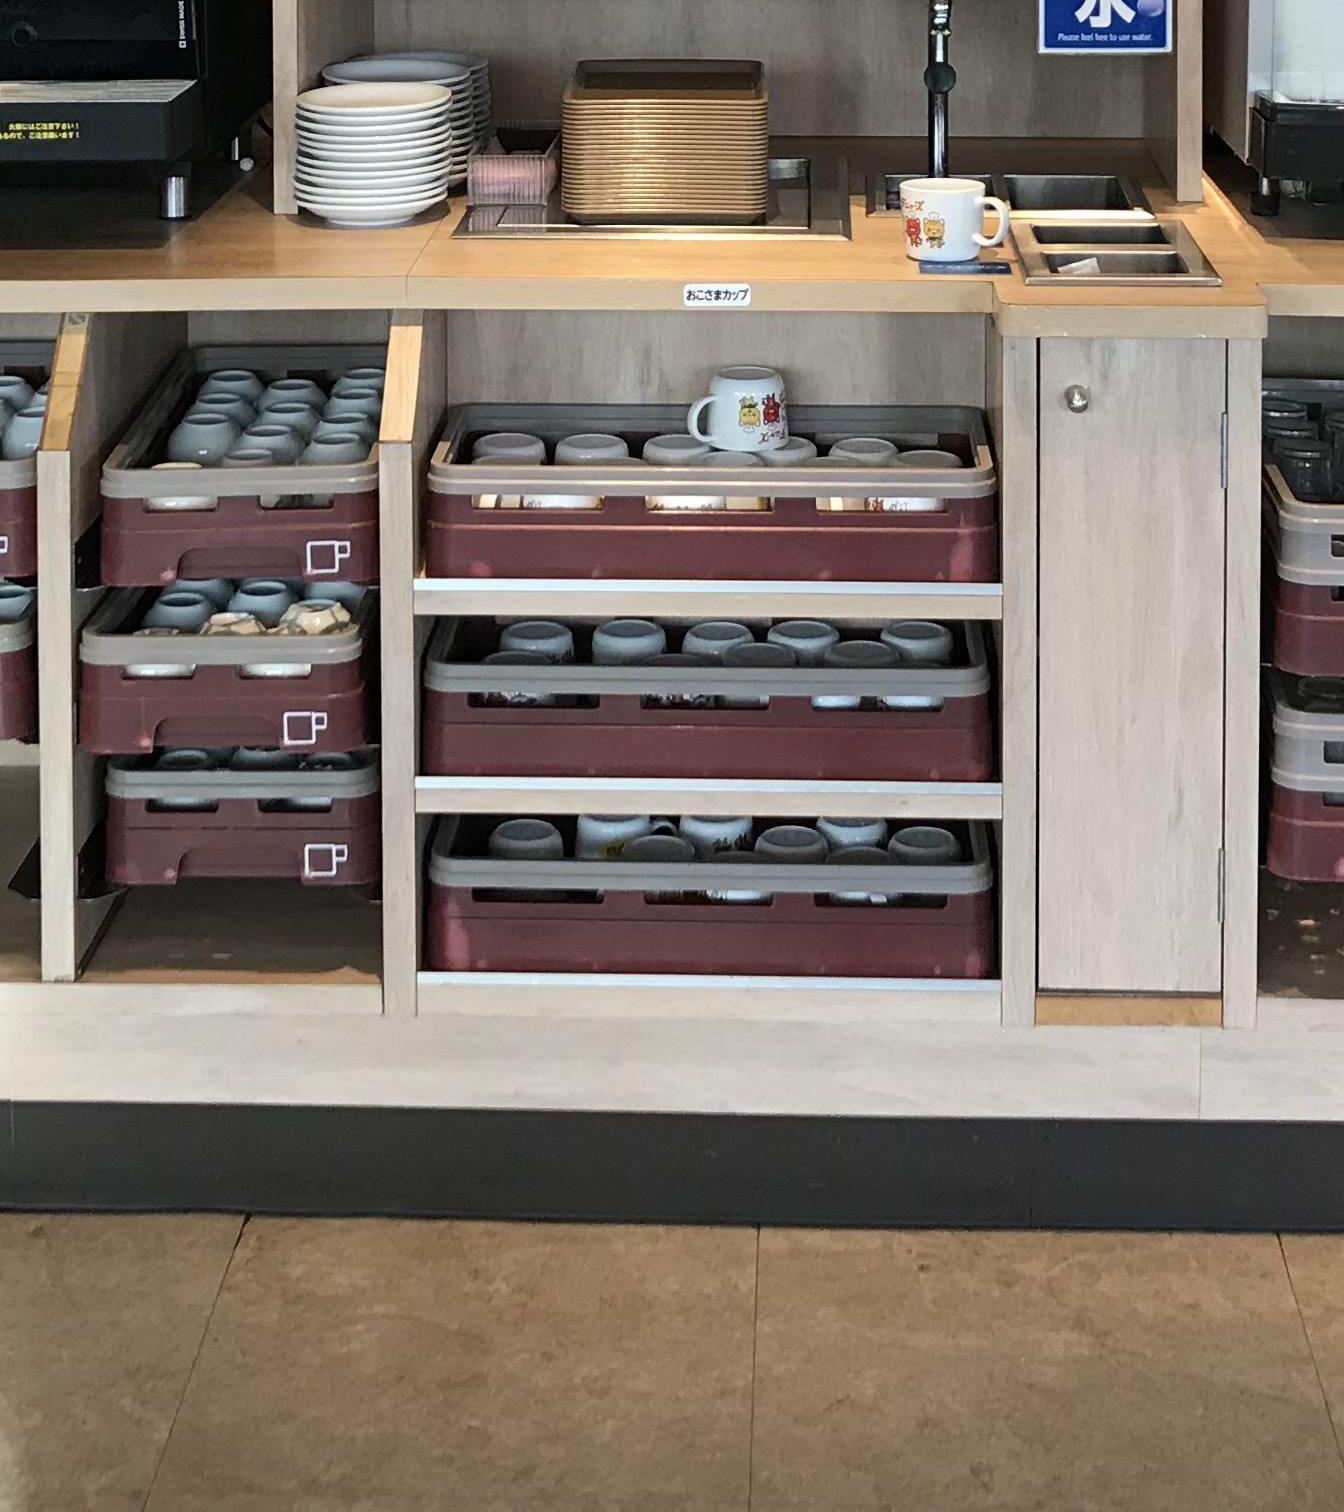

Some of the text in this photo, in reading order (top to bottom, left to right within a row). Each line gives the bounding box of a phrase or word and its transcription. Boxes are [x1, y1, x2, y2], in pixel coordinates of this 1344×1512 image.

[1057, 33, 1079, 41] Please
[686, 287, 749, 302] おこさまカップ
